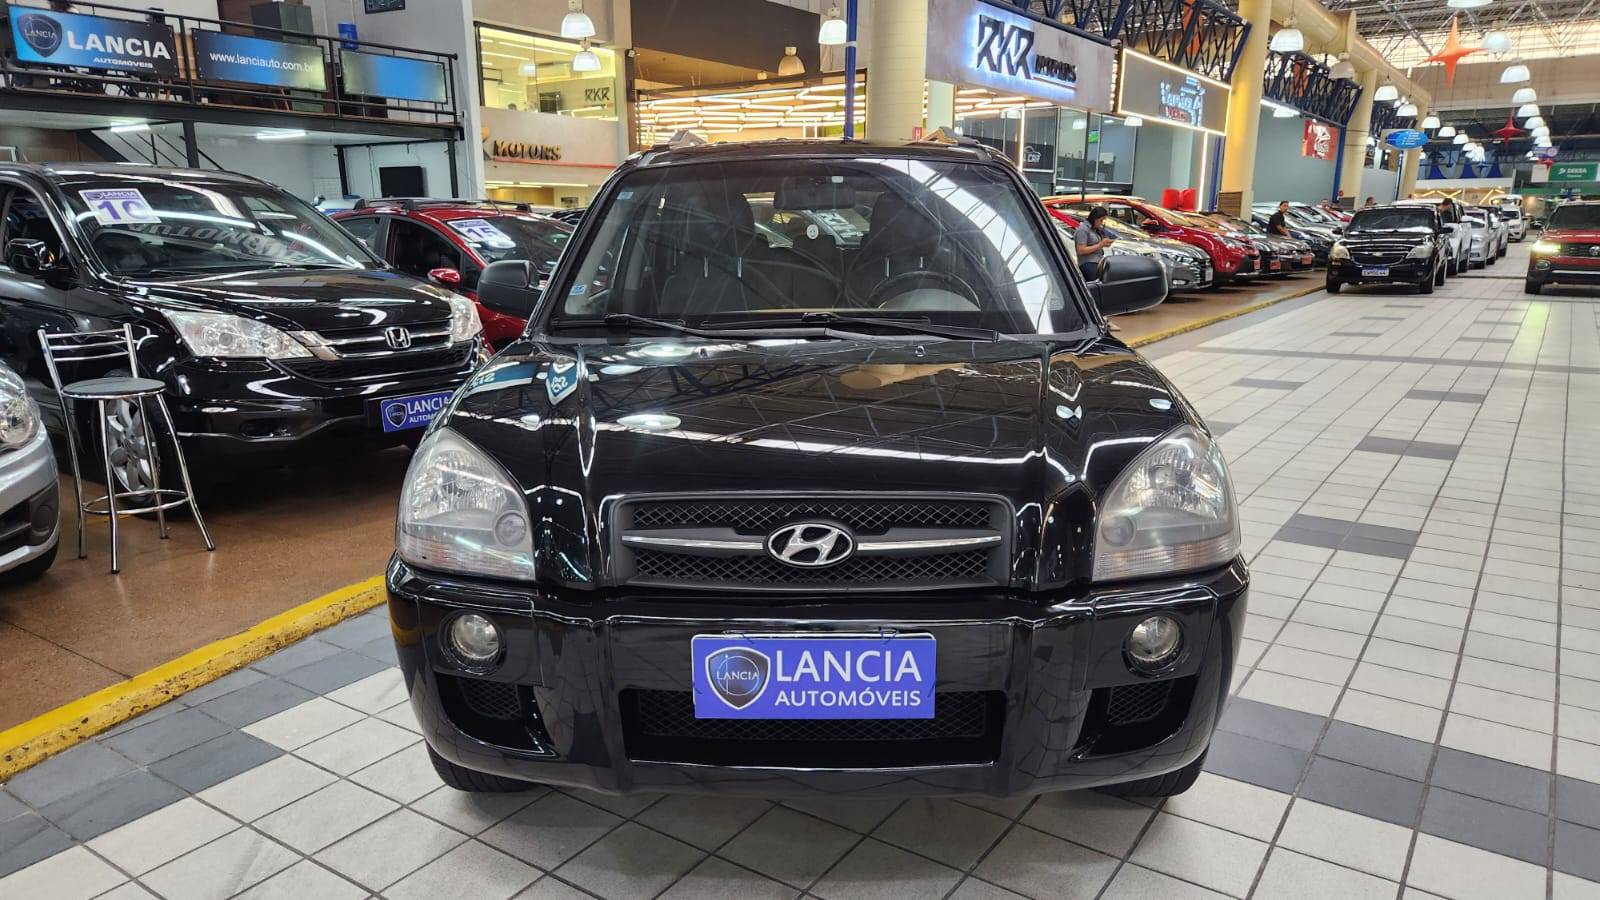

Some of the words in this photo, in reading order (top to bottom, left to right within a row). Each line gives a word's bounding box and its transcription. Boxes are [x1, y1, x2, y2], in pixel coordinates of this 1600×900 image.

[67, 30, 171, 60] LANCIA
[977, 14, 1034, 80] RKR
[209, 52, 313, 73] www.lanciauto.com.br
[584, 87, 610, 102] RKR
[493, 140, 561, 161] MOTORS
[716, 671, 760, 681] LANCIA
[775, 650, 922, 683] LANCIA
[774, 687, 922, 707] AUTOMÓVEIS
